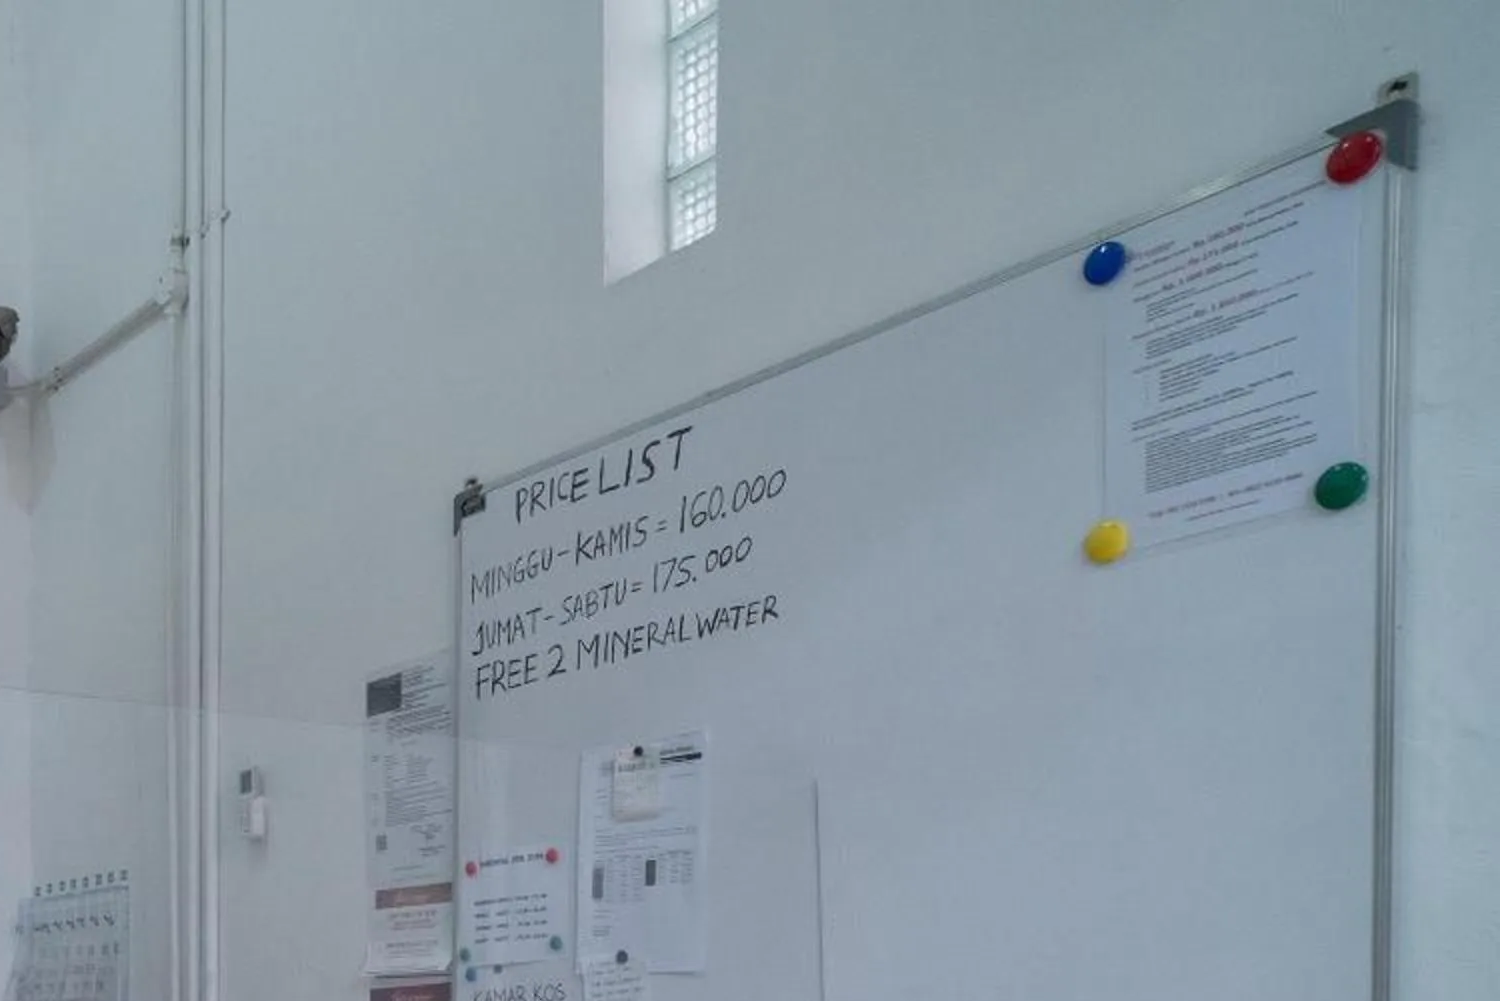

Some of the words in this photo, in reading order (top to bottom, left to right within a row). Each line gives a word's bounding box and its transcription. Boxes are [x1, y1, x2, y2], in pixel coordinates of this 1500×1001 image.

[515, 467, 590, 524] PRICE
[599, 425, 693, 497] LIST
[678, 468, 788, 534] 160.000
[653, 536, 753, 593] 175.000
[475, 653, 539, 700] FREE
[548, 645, 567, 677] 2
[576, 624, 691, 670] MINERAL
[696, 593, 780, 640] WATER
